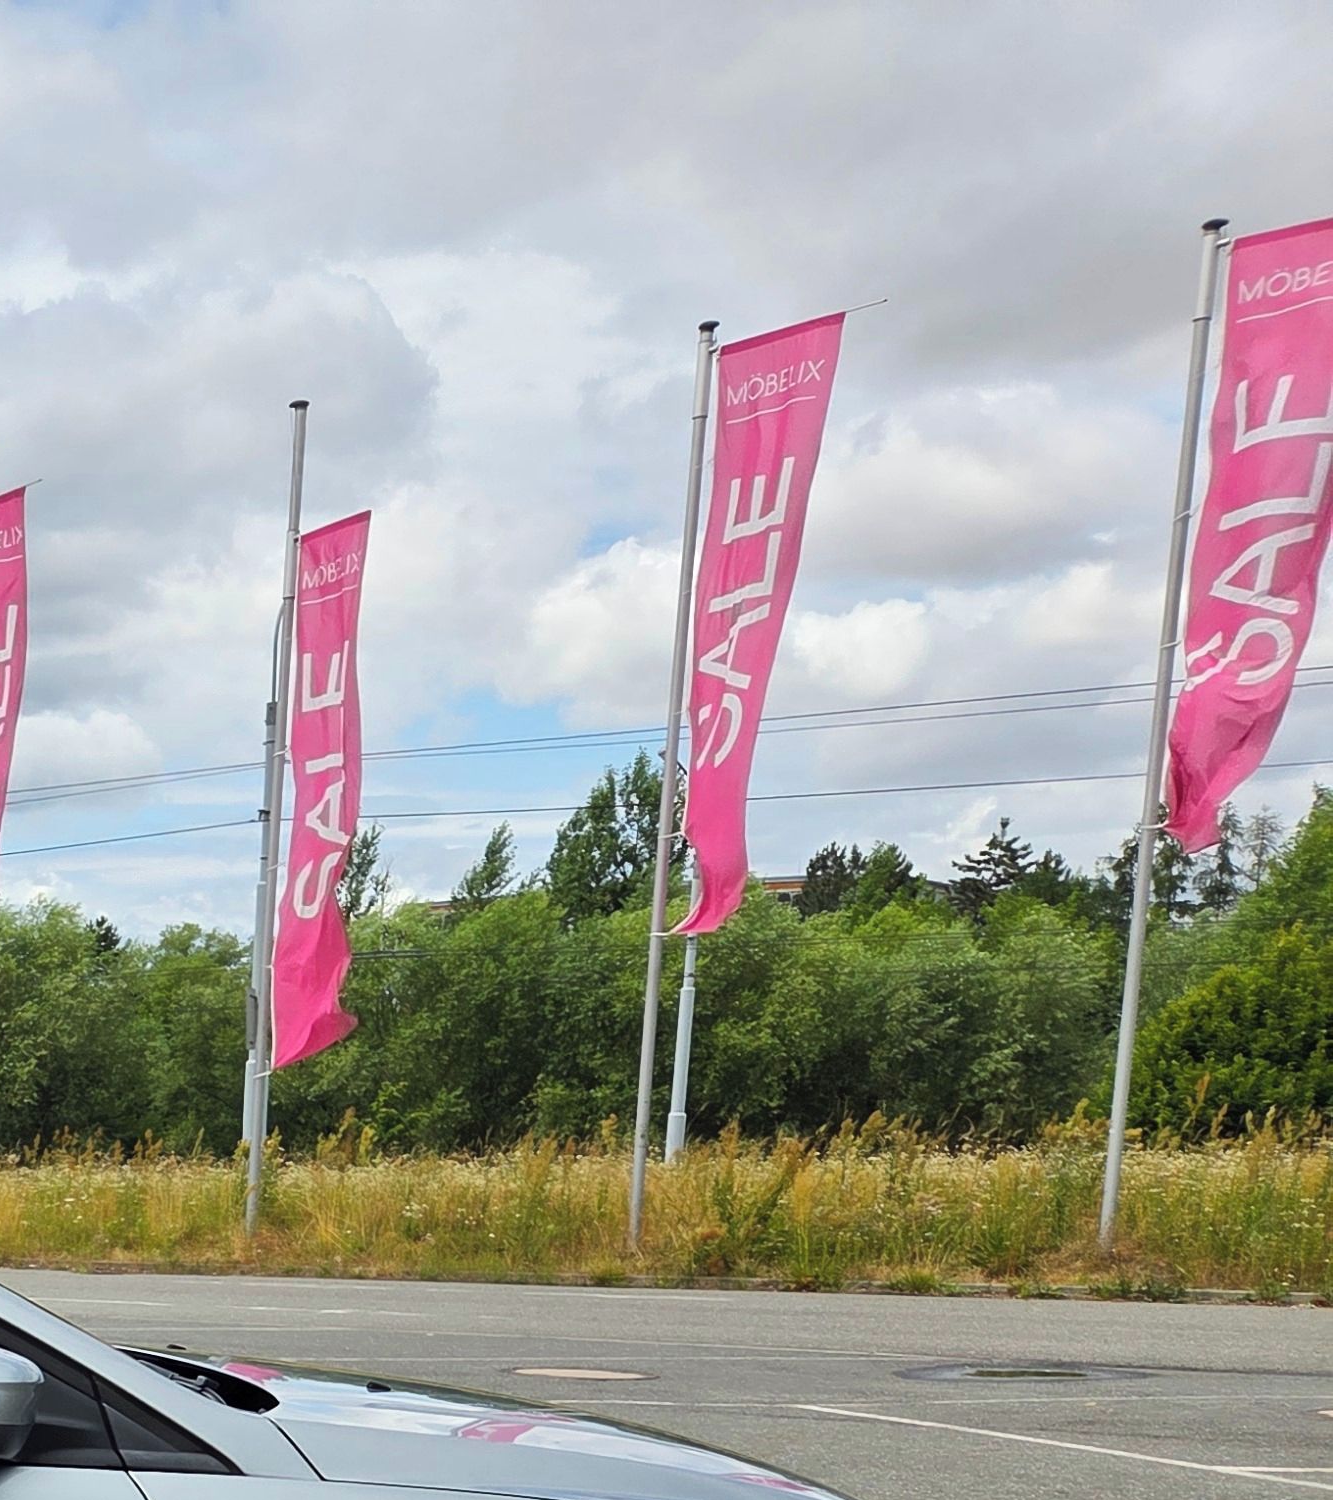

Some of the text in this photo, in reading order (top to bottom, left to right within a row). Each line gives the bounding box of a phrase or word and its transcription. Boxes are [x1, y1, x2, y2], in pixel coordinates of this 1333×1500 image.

[726, 359, 826, 407] MÖBELIX
[695, 456, 795, 770] SALE
[1183, 374, 1333, 692] SALE
[293, 640, 351, 919] SALE
